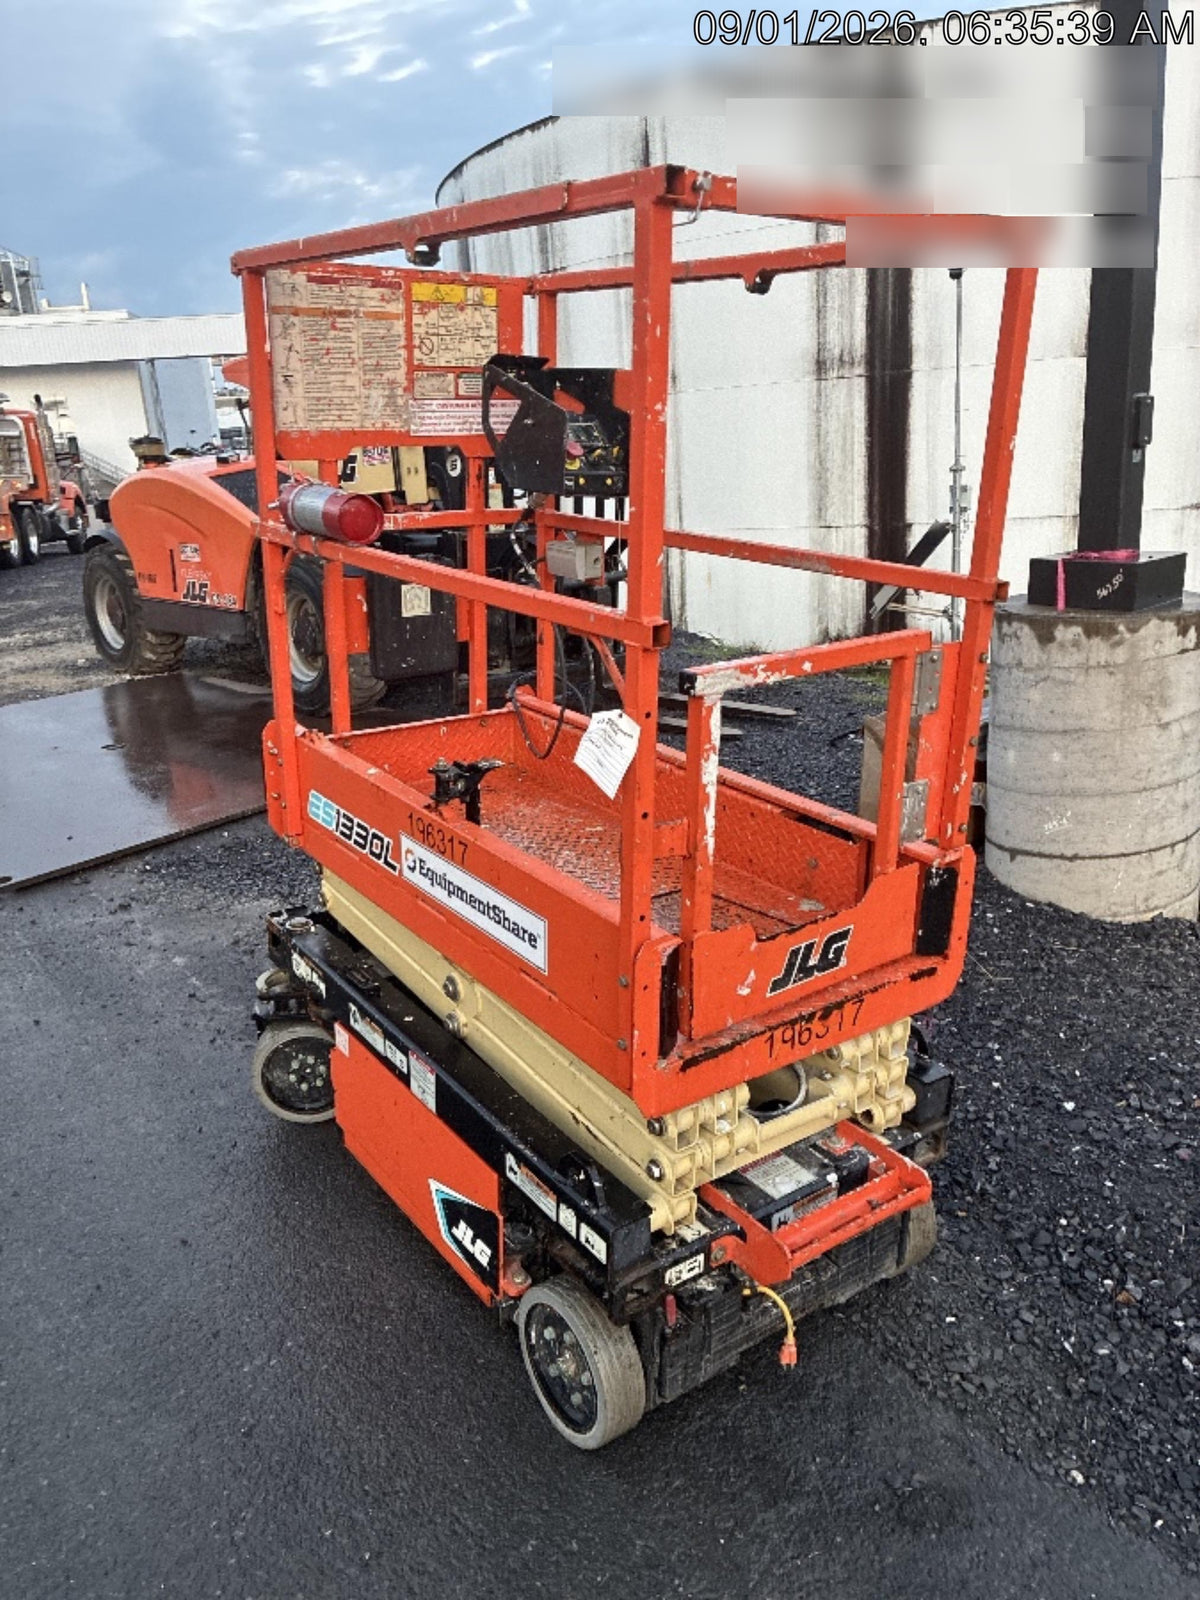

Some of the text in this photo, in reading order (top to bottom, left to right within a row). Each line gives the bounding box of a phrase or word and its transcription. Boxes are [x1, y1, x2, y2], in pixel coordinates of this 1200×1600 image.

[181, 580, 208, 604] JLG
[308, 789, 400, 876] ES1330L
[407, 812, 469, 867] 196317
[418, 857, 539, 950] EquipmentShare
[767, 925, 855, 997] JLG
[764, 998, 865, 1059] 196317
[451, 1218, 493, 1269] JLG
